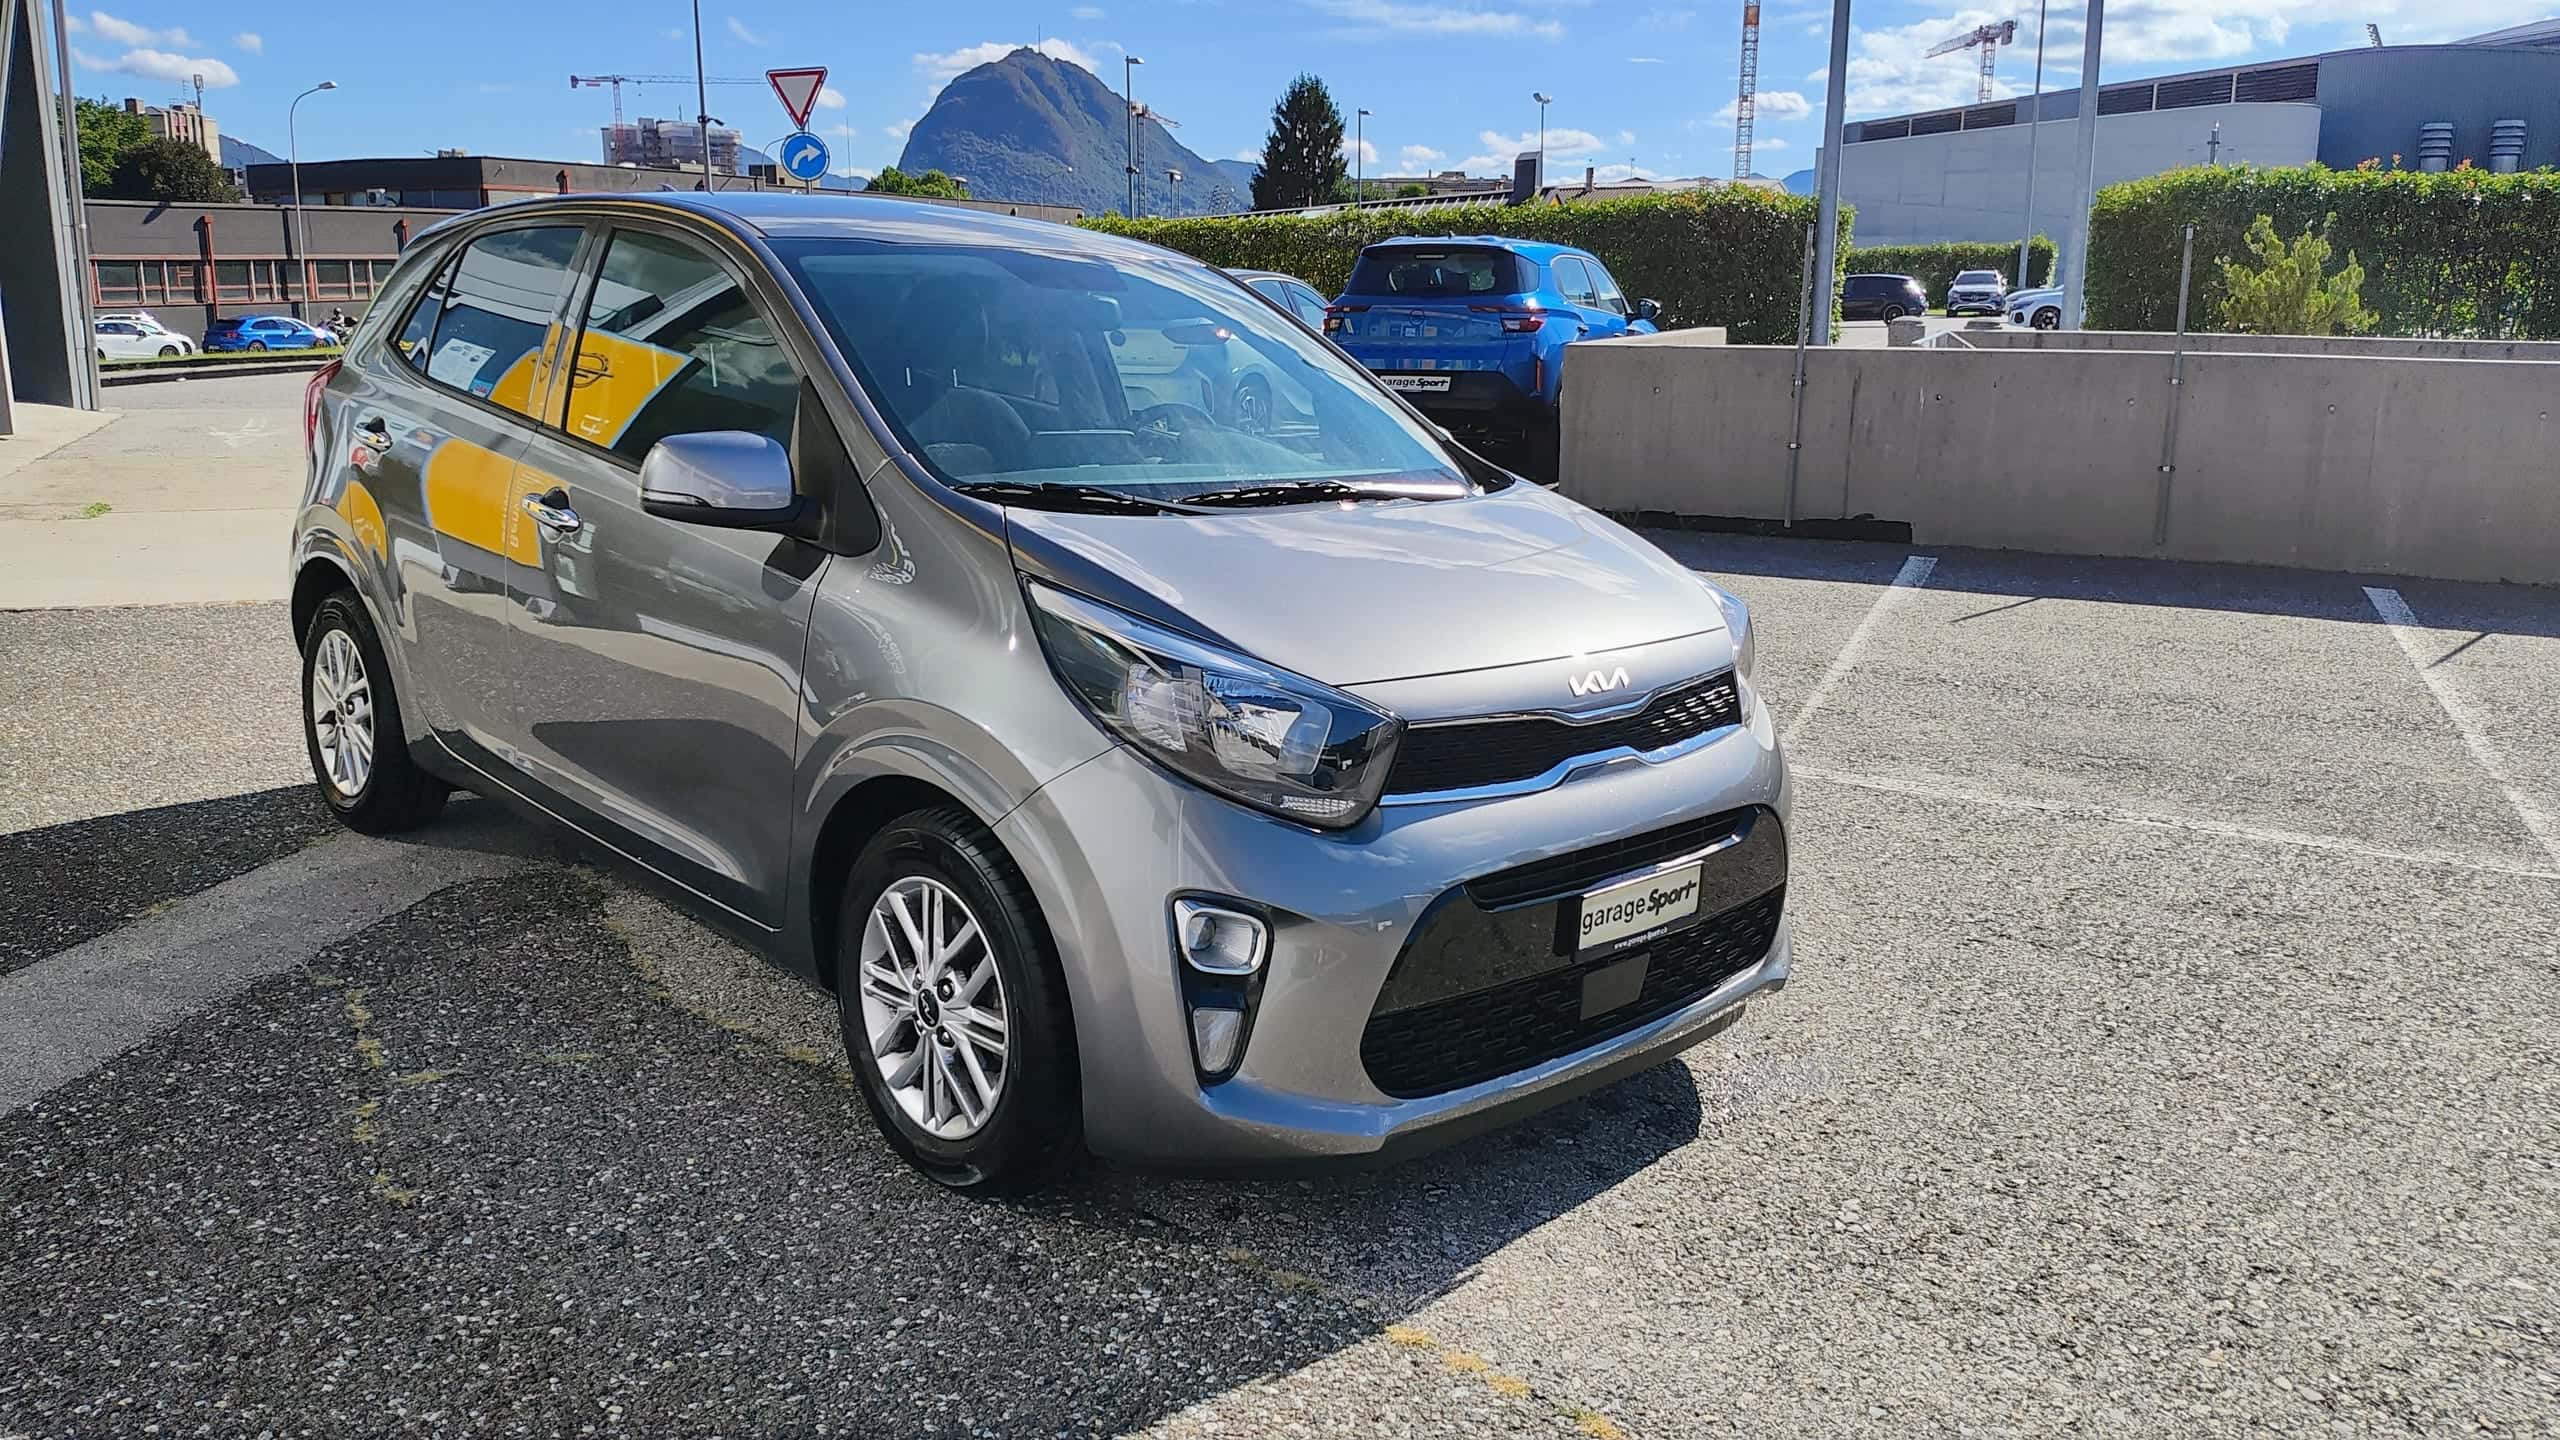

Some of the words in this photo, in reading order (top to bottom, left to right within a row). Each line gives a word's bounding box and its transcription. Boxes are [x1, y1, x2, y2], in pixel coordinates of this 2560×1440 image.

[1567, 666, 1630, 697] KIA
[1582, 897, 1645, 935] garage
[1646, 880, 1697, 916] Sport
